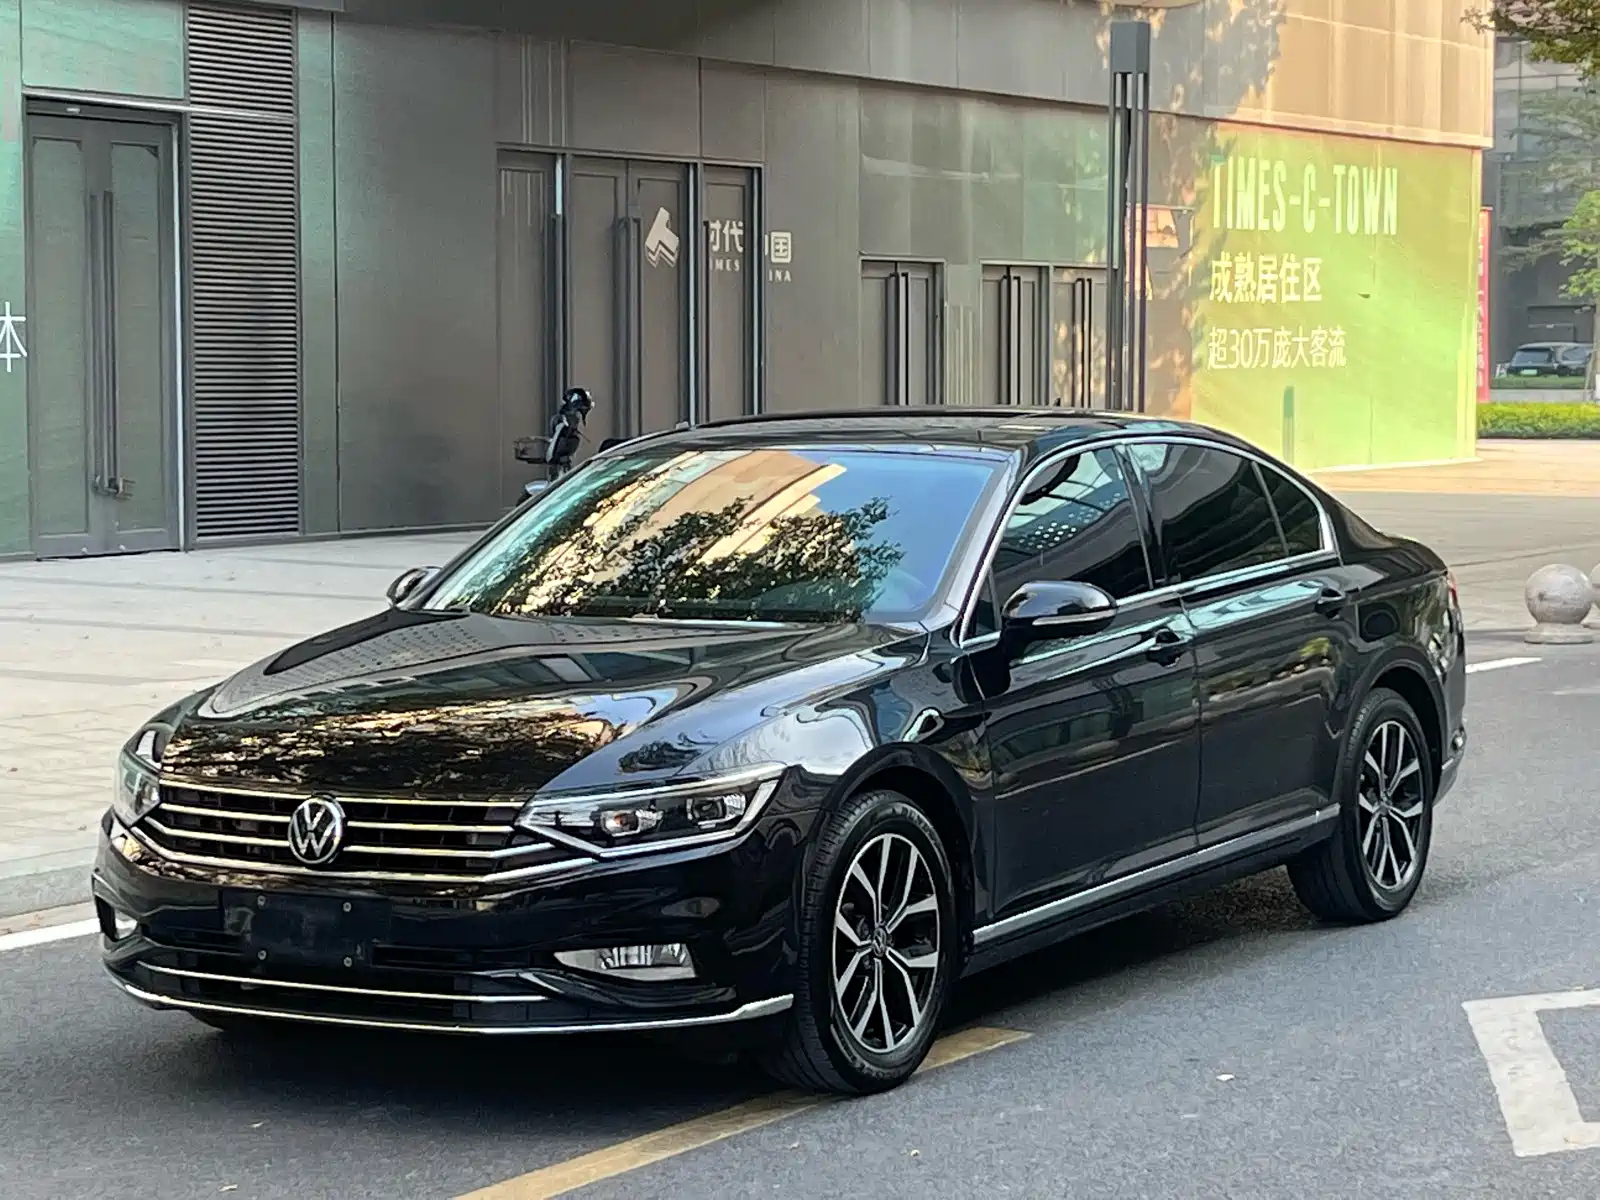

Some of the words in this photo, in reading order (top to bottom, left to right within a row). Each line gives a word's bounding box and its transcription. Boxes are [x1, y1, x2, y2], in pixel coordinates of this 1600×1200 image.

[765, 231, 792, 263] 国
[1209, 252, 1323, 304] 成熟居住区
[1207, 324, 1347, 369] 超30万庞大客流
